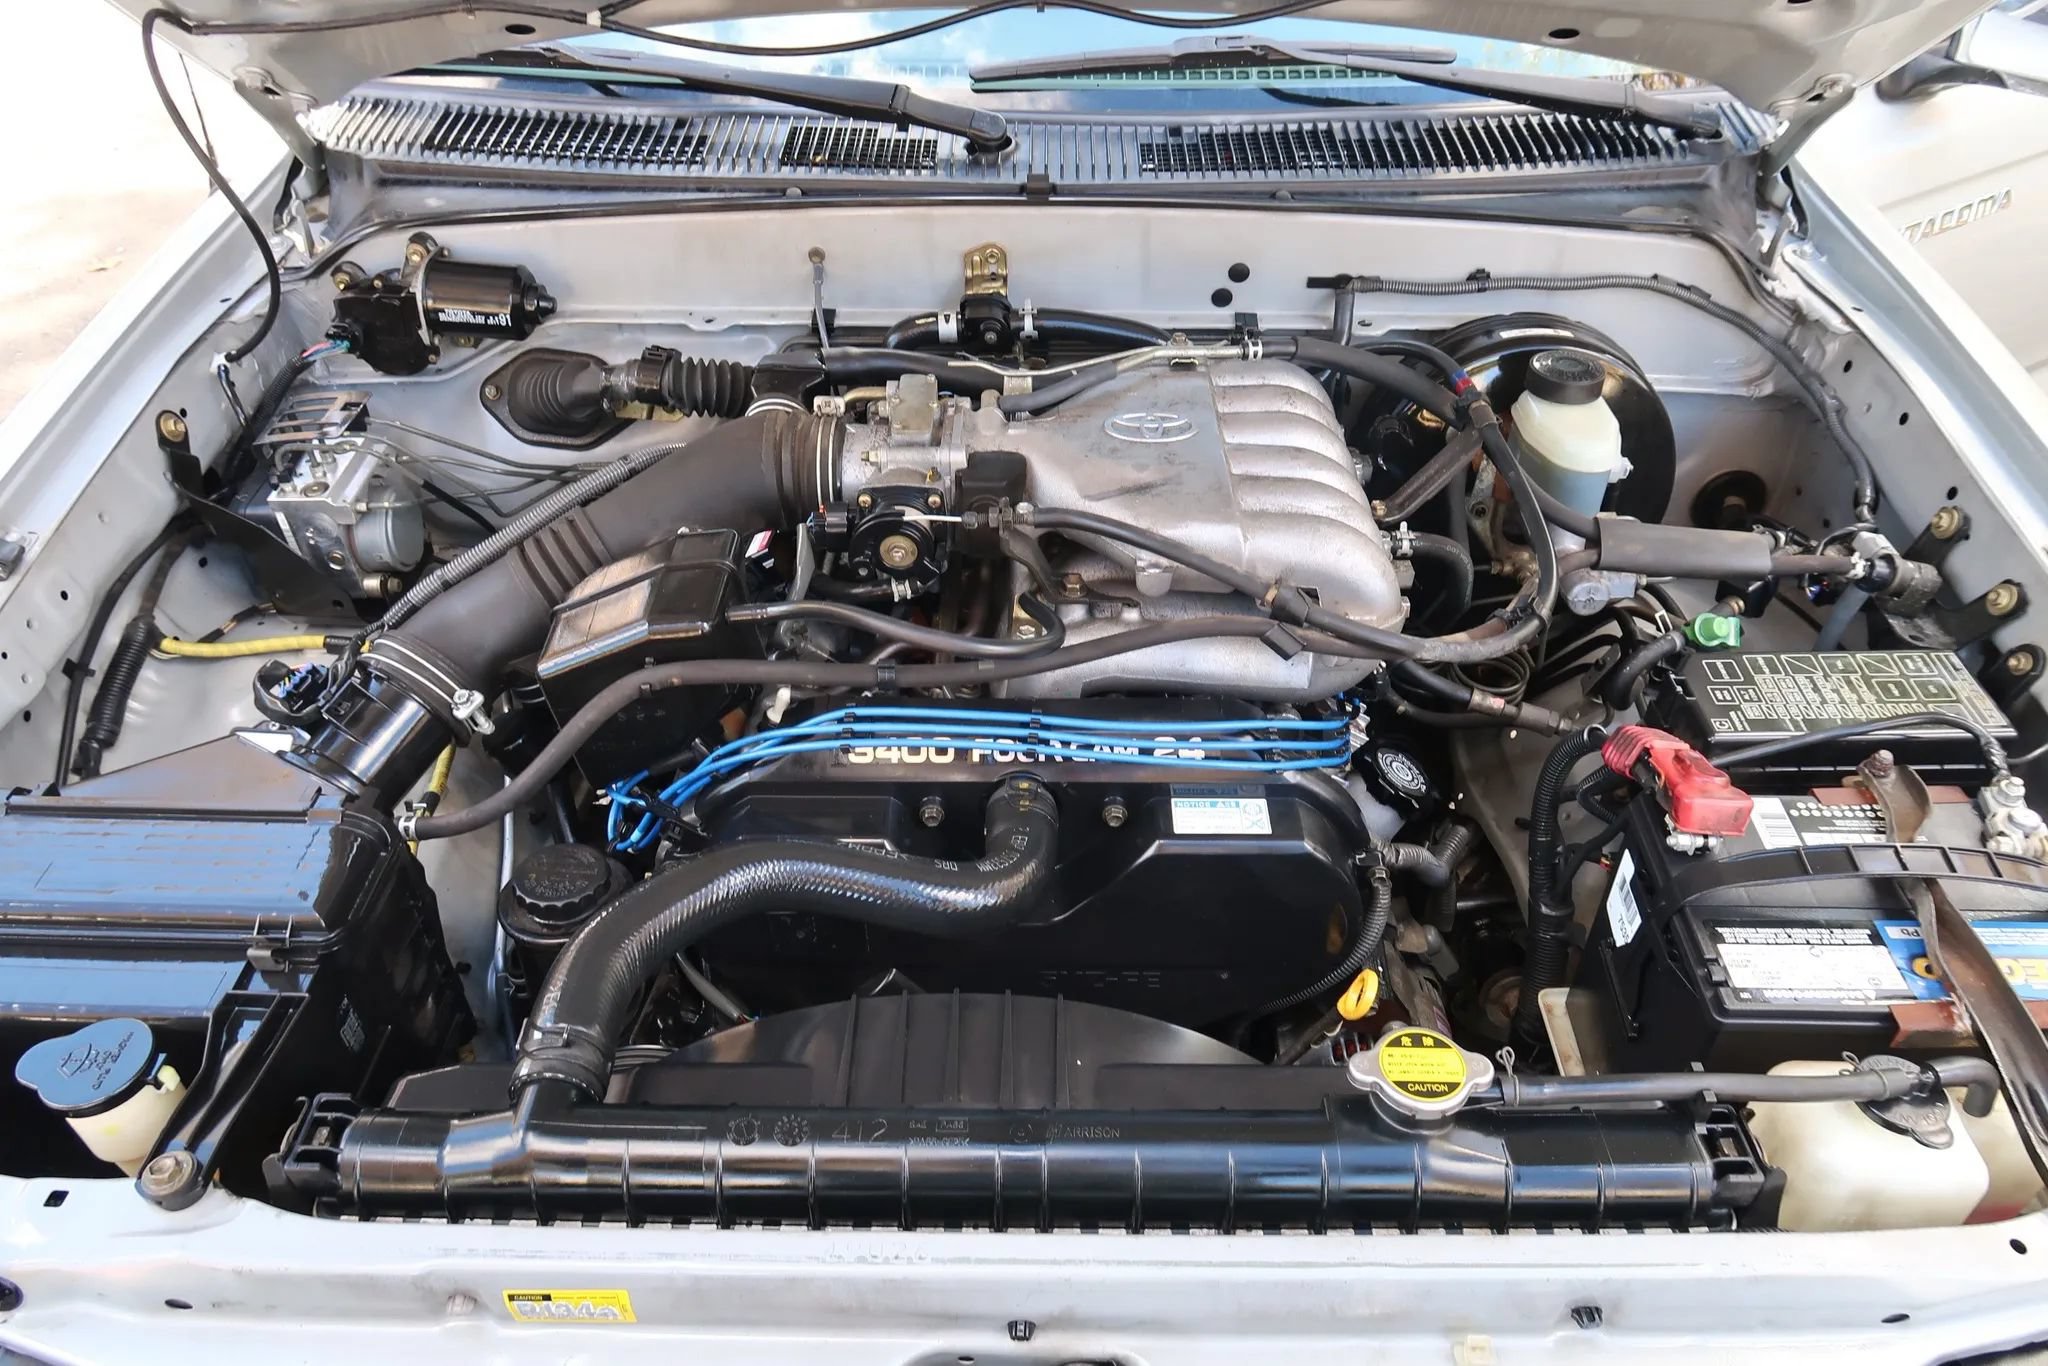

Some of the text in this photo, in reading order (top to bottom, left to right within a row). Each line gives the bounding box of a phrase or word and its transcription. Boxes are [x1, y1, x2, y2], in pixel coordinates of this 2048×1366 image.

[1900, 188, 2012, 243] TACOMA
[1901, 928, 1921, 938] Pb
[1407, 1082, 1449, 1093] CAUTION
